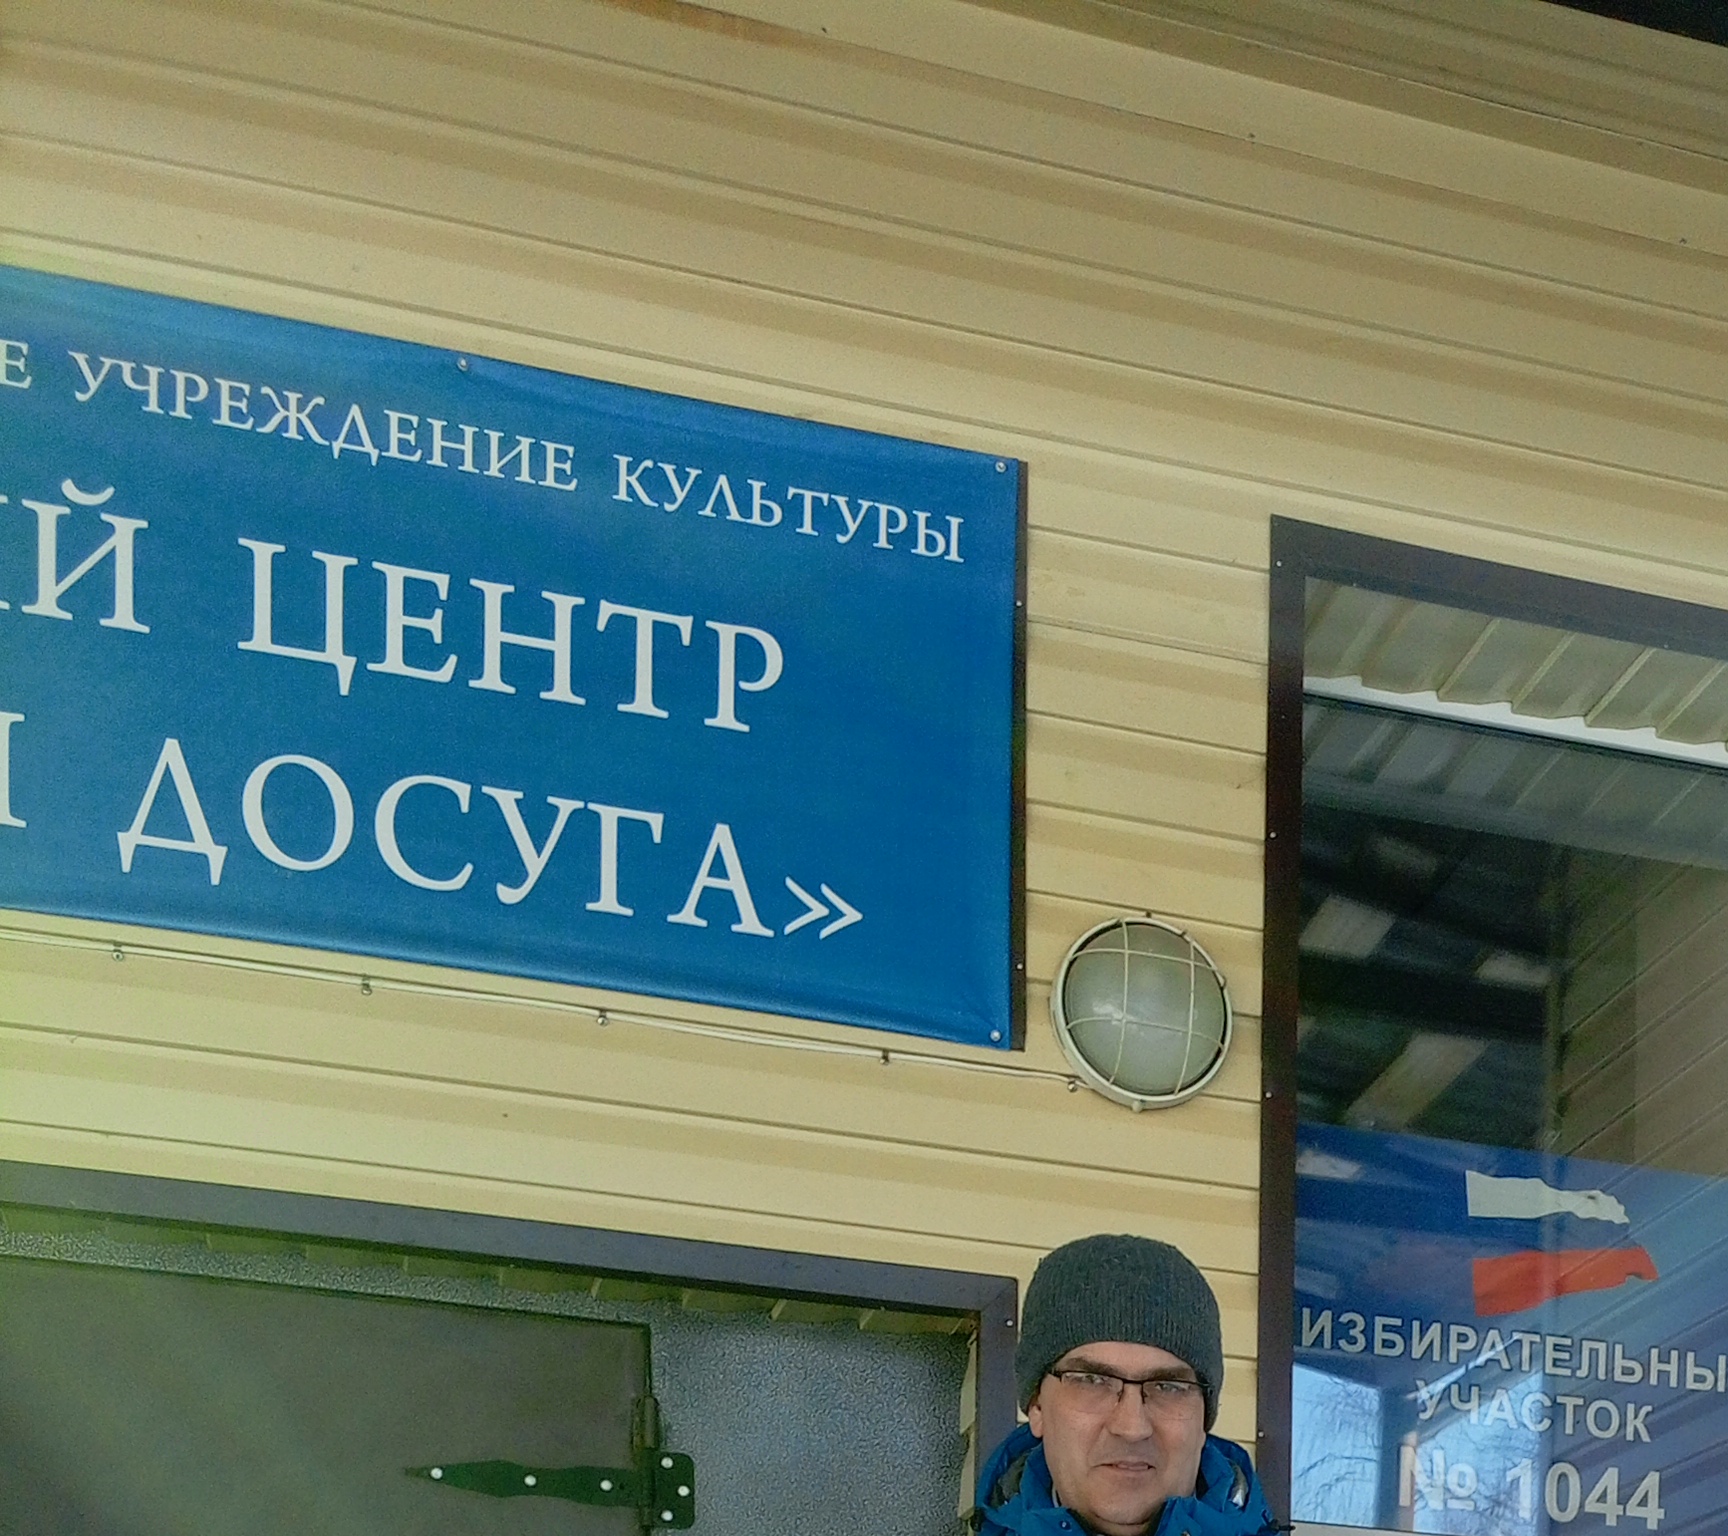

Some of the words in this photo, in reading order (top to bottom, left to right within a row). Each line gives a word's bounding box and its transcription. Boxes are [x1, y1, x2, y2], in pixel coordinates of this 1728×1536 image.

[67, 350, 577, 491] УЧРЕЖДЕНИЕ
[612, 454, 965, 562] КУЛЬТУРЫ
[0, 478, 150, 634] Й
[237, 538, 784, 732] ЦЕНТР
[117, 738, 863, 939] ДОСУГА»
[1399, 1444, 1477, 1511] №
[1506, 1458, 1666, 1530] 1044
[1415, 1379, 1653, 1443] УЧАСТОК
